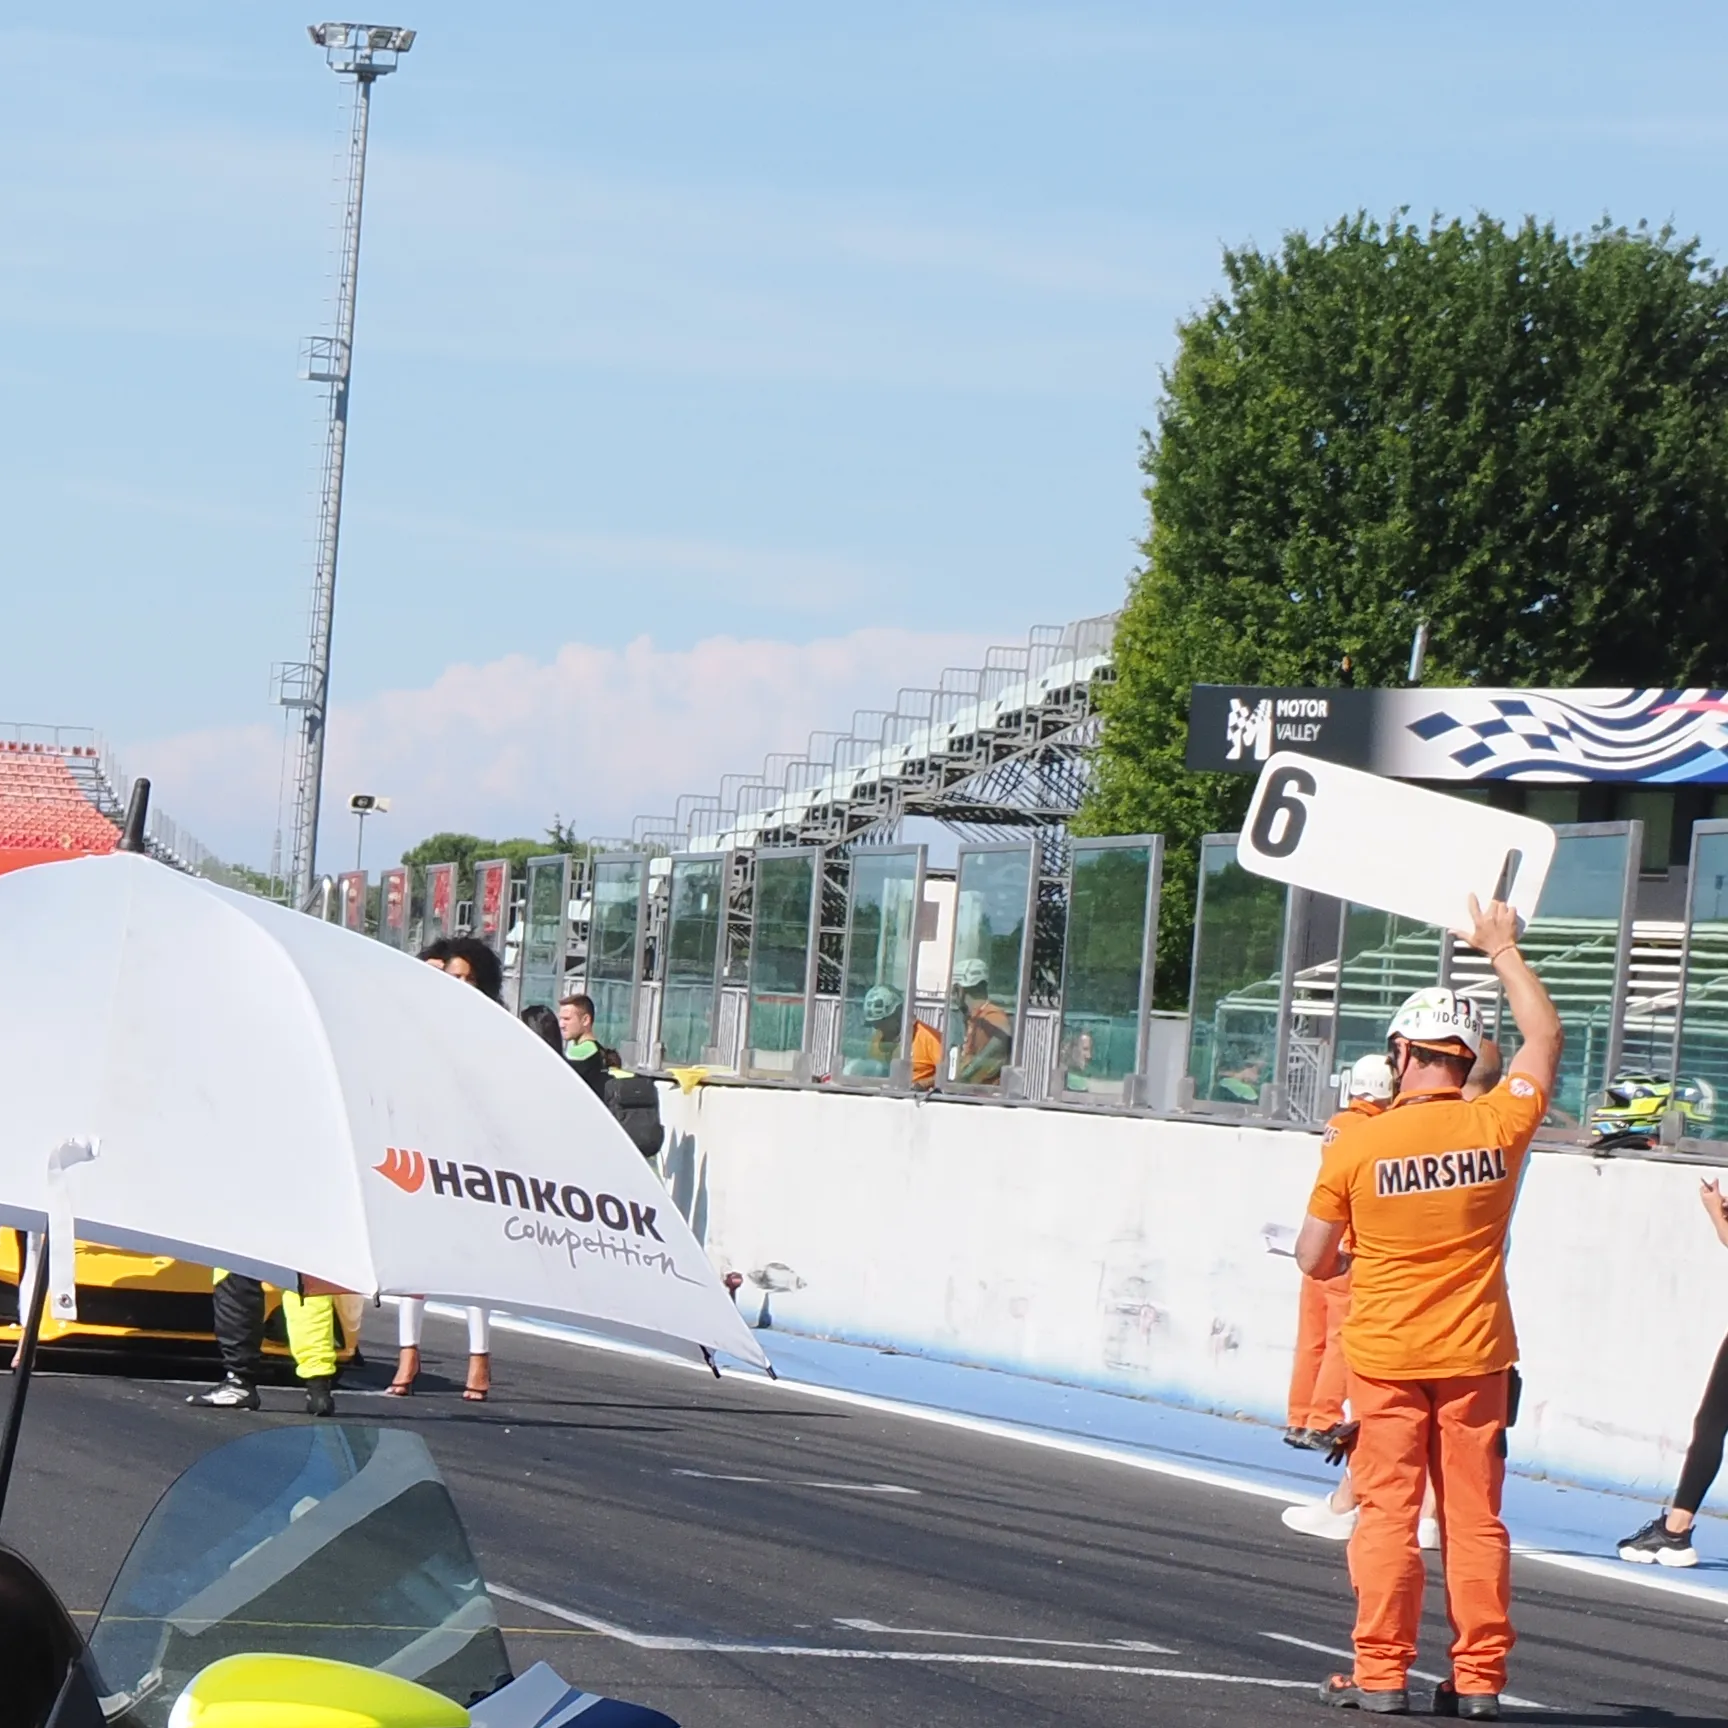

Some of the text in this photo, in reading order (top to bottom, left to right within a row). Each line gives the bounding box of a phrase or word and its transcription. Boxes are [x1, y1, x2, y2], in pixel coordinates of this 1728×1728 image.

[1276, 699, 1328, 718] MOTOR
[1276, 723, 1322, 741] VALLEY
[1250, 766, 1317, 859] 6
[1377, 1147, 1507, 1196] MARSHAL
